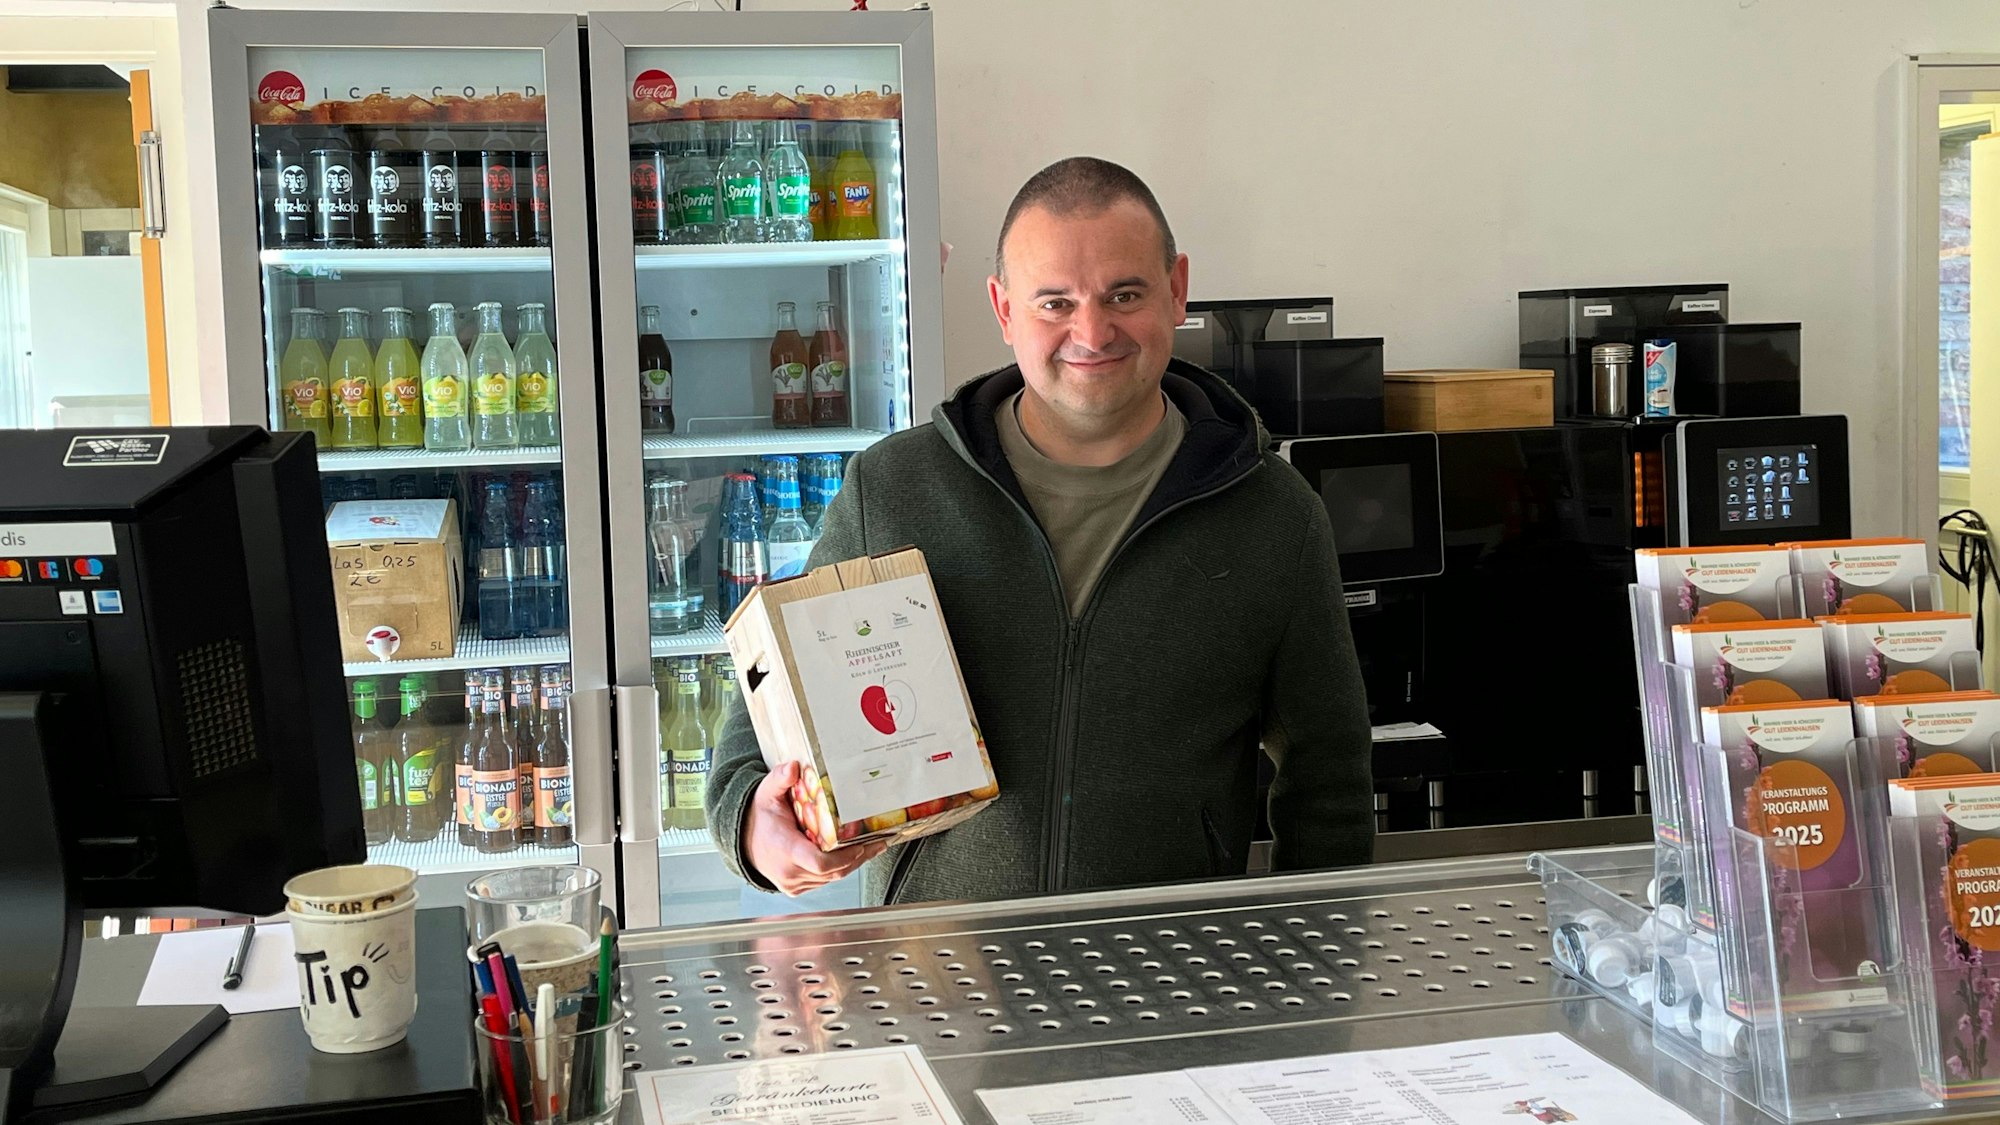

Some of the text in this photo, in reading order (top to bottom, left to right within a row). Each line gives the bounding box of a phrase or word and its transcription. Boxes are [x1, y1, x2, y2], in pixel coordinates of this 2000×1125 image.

[261, 86, 302, 100] Coca-Cola
[323, 86, 391, 99] ICE
[635, 84, 674, 98] Coca-Cola
[694, 85, 757, 97] ICE
[727, 184, 762, 200] Sprite
[682, 193, 714, 209] Sprite
[845, 640, 901, 659] RHEINISCHER
[848, 648, 903, 667] APFELSAFT
[680, 673, 696, 682] BIO
[484, 691, 502, 701] BIO
[516, 684, 532, 694] BIO
[408, 766, 433, 778] fuze
[409, 776, 429, 786] tea
[475, 781, 517, 793] BIONADE
[486, 793, 506, 801] EISTEE
[1772, 824, 1824, 847] 2025
[295, 950, 370, 1019] Tip
[710, 1082, 878, 1107] Getränkekarte
[710, 1093, 880, 1117] SELBSTBEDIENUNG
